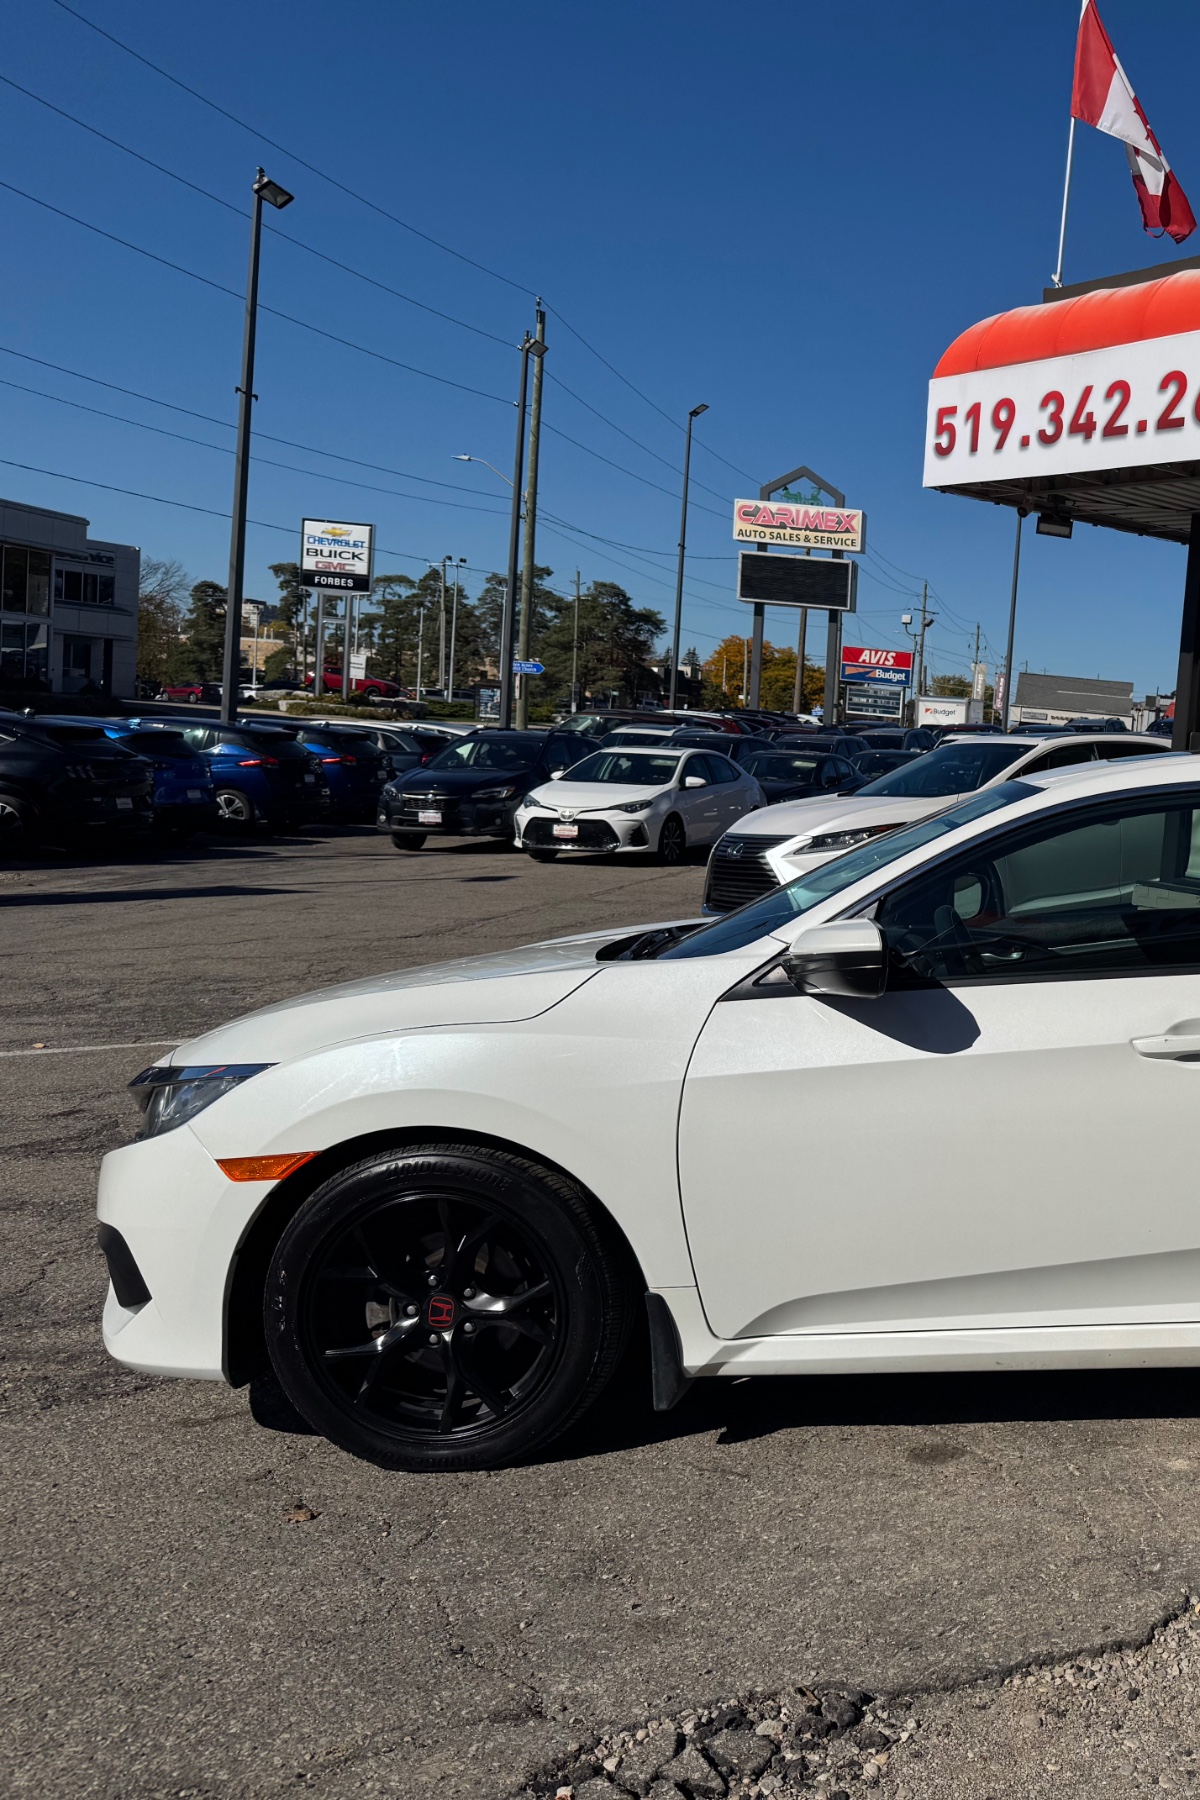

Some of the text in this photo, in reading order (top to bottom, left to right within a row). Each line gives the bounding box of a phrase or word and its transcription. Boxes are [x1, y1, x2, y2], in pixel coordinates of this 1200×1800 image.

[737, 504, 857, 533] CARIMEX
[307, 536, 366, 548] CHEVROLET
[737, 529, 857, 547] AUTO SALES & SERVICE
[306, 547, 365, 561] BUICK
[315, 560, 356, 572] GMC
[314, 576, 354, 587] FORBES
[858, 649, 896, 666] AVIS
[875, 669, 906, 682] Budget
[933, 708, 956, 717] Budget
